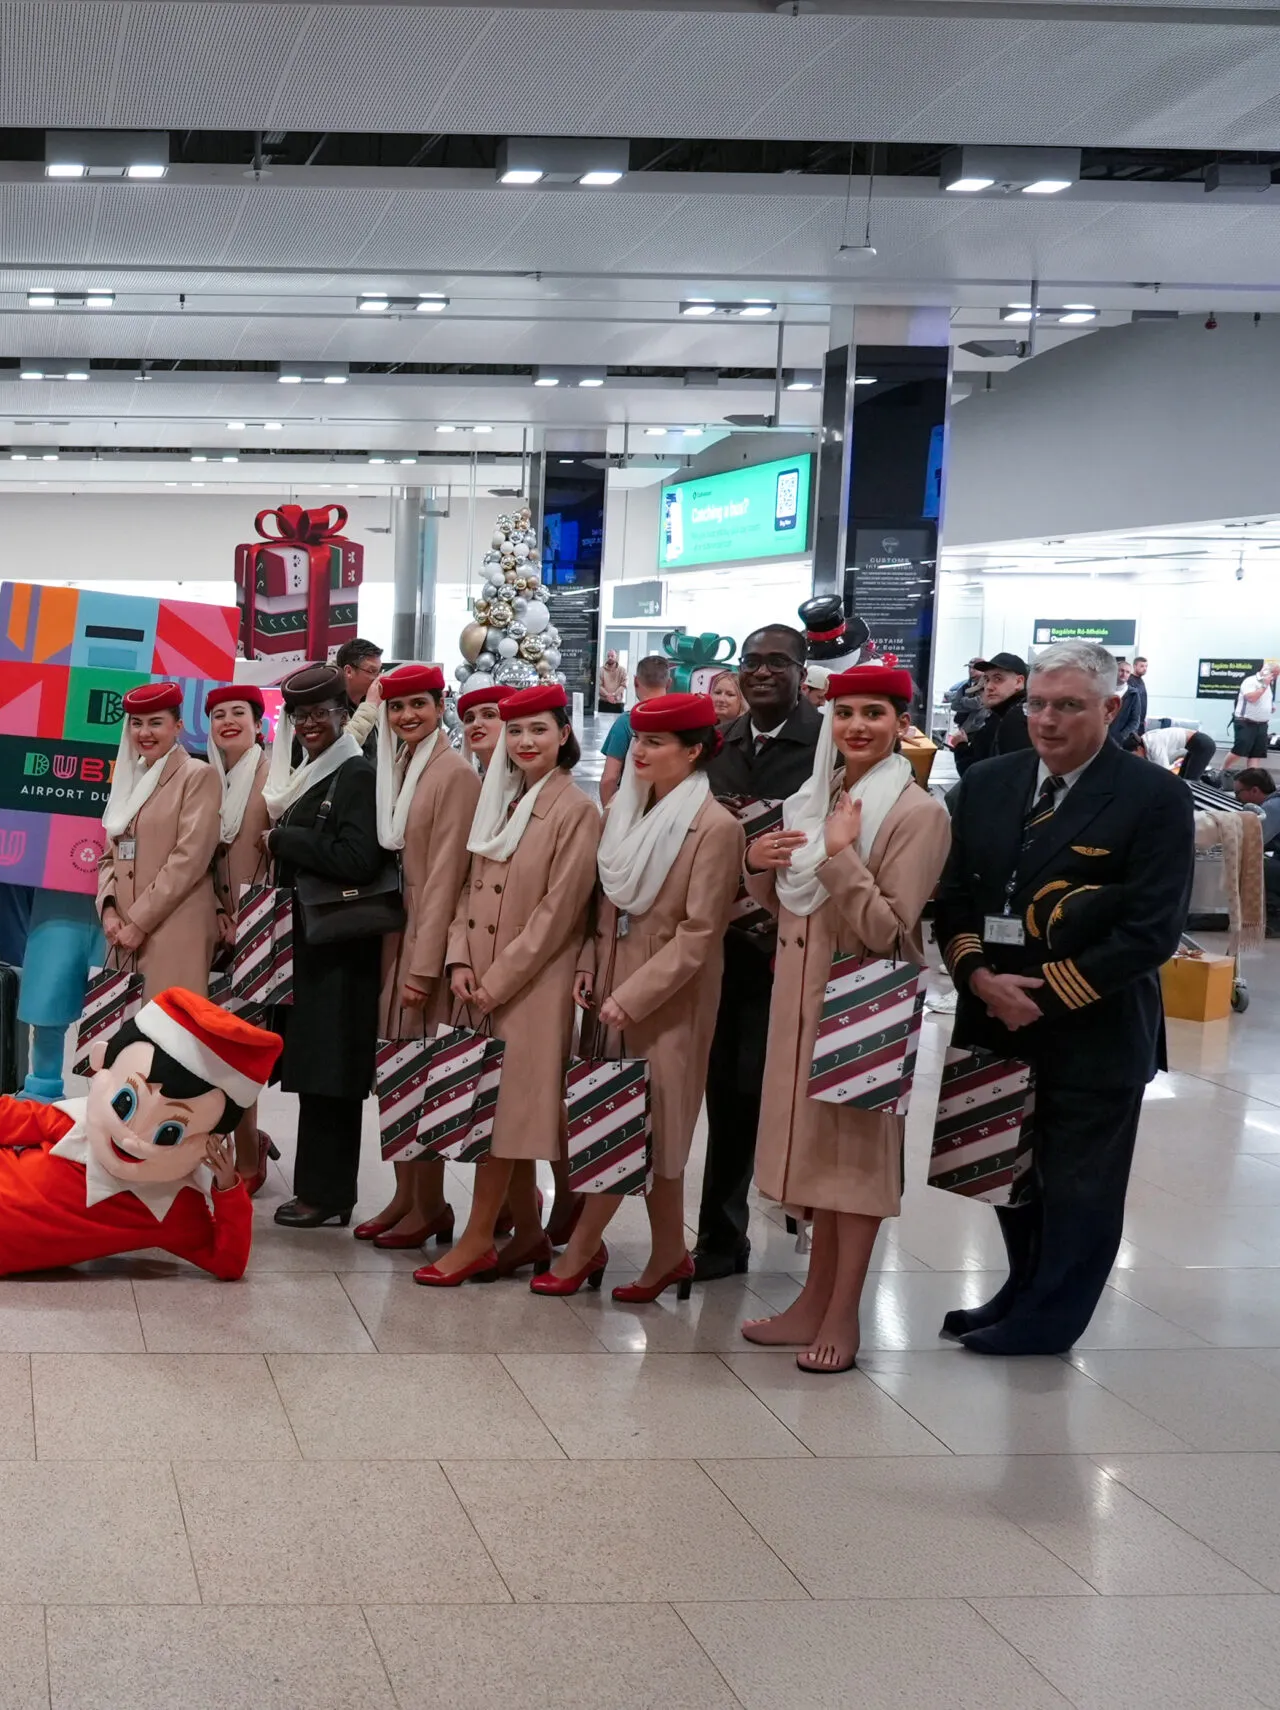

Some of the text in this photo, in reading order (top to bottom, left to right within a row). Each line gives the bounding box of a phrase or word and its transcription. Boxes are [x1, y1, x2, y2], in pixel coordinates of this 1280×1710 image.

[23, 752, 116, 784] DUB
[20, 785, 111, 801] AIRPORT DU
